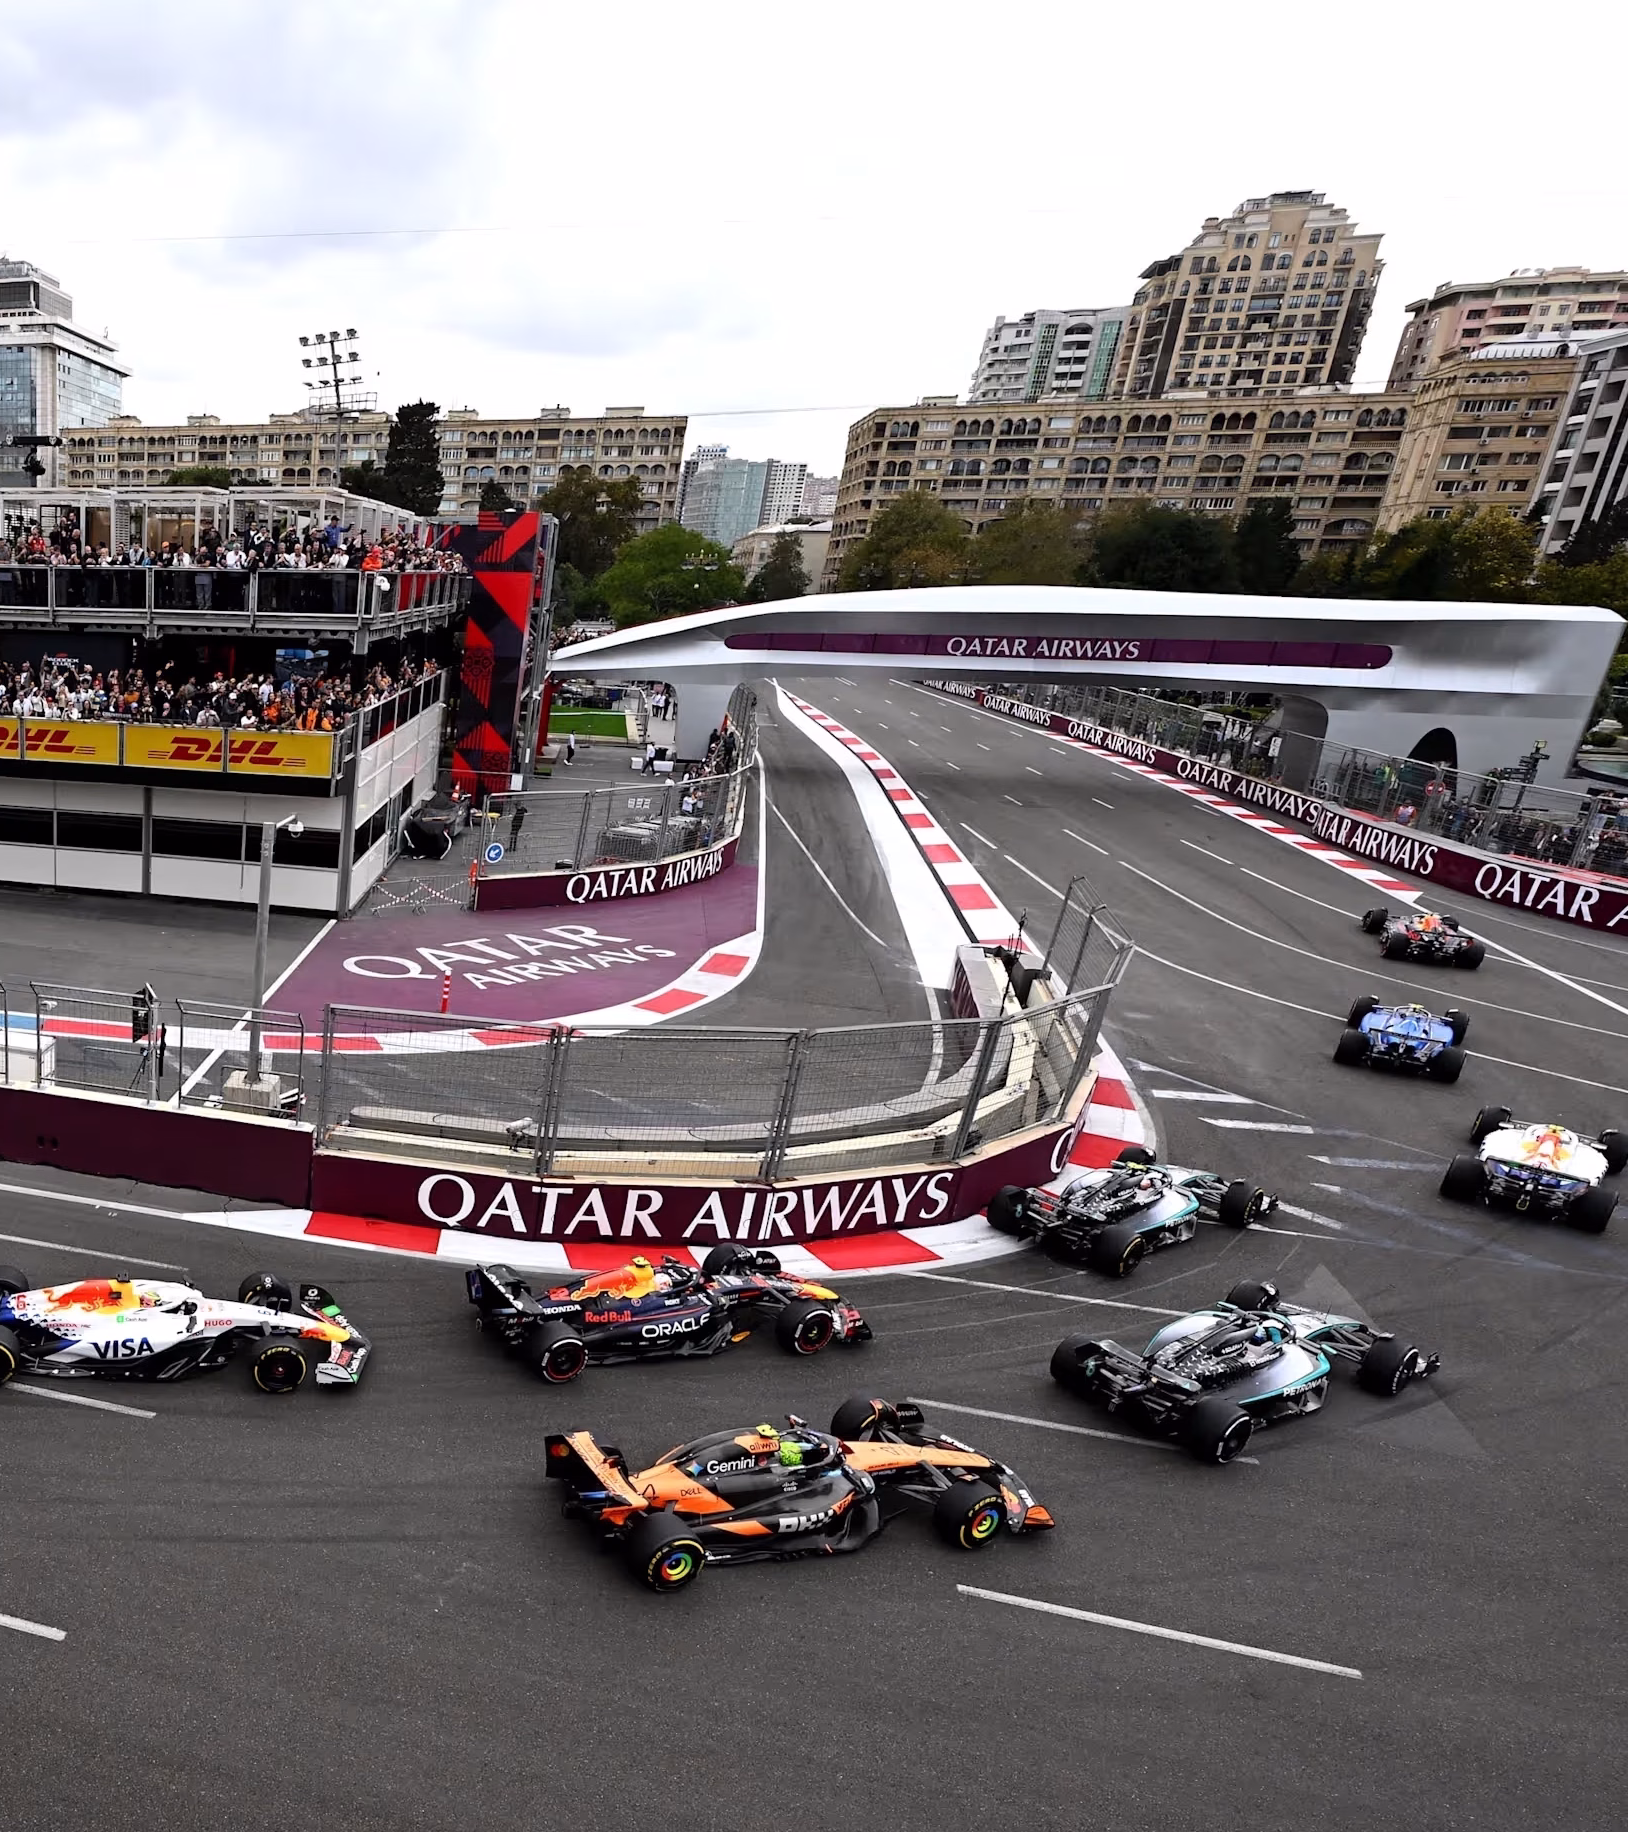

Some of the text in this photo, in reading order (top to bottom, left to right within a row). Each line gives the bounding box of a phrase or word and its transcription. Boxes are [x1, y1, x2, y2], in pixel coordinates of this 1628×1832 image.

[946, 636, 1141, 660] QATAR AIRWAYS
[943, 681, 977, 699] AIRWAYS
[983, 695, 1052, 728] QATAR AIRWAYS
[170, 737, 285, 766] DHL
[1067, 721, 1157, 765] QATAR AIRWAYS
[1176, 758, 1321, 826] QATAR AIRWAYS
[1314, 804, 1439, 875] ATAR AIRWAYS
[565, 848, 725, 904] QATAR AIRWAYS
[1474, 863, 1600, 922] QATAR
[342, 924, 677, 990] QATAR AIRWAYS
[417, 1172, 954, 1239] QATAR AIRWAYS
[15, 1294, 27, 1311] 6
[542, 1304, 583, 1315] HONDA
[204, 1319, 233, 1328] HUGO
[584, 1310, 633, 1323] Red Bull
[88, 1336, 155, 1360] VISA
[266, 1346, 291, 1356] ZERO
[1283, 1376, 1328, 1398] PETRONAS
[749, 1439, 777, 1452] allwyn
[706, 1455, 756, 1475] Gemini
[680, 1487, 702, 1497] DELL
[974, 1496, 997, 1511] ZERO
